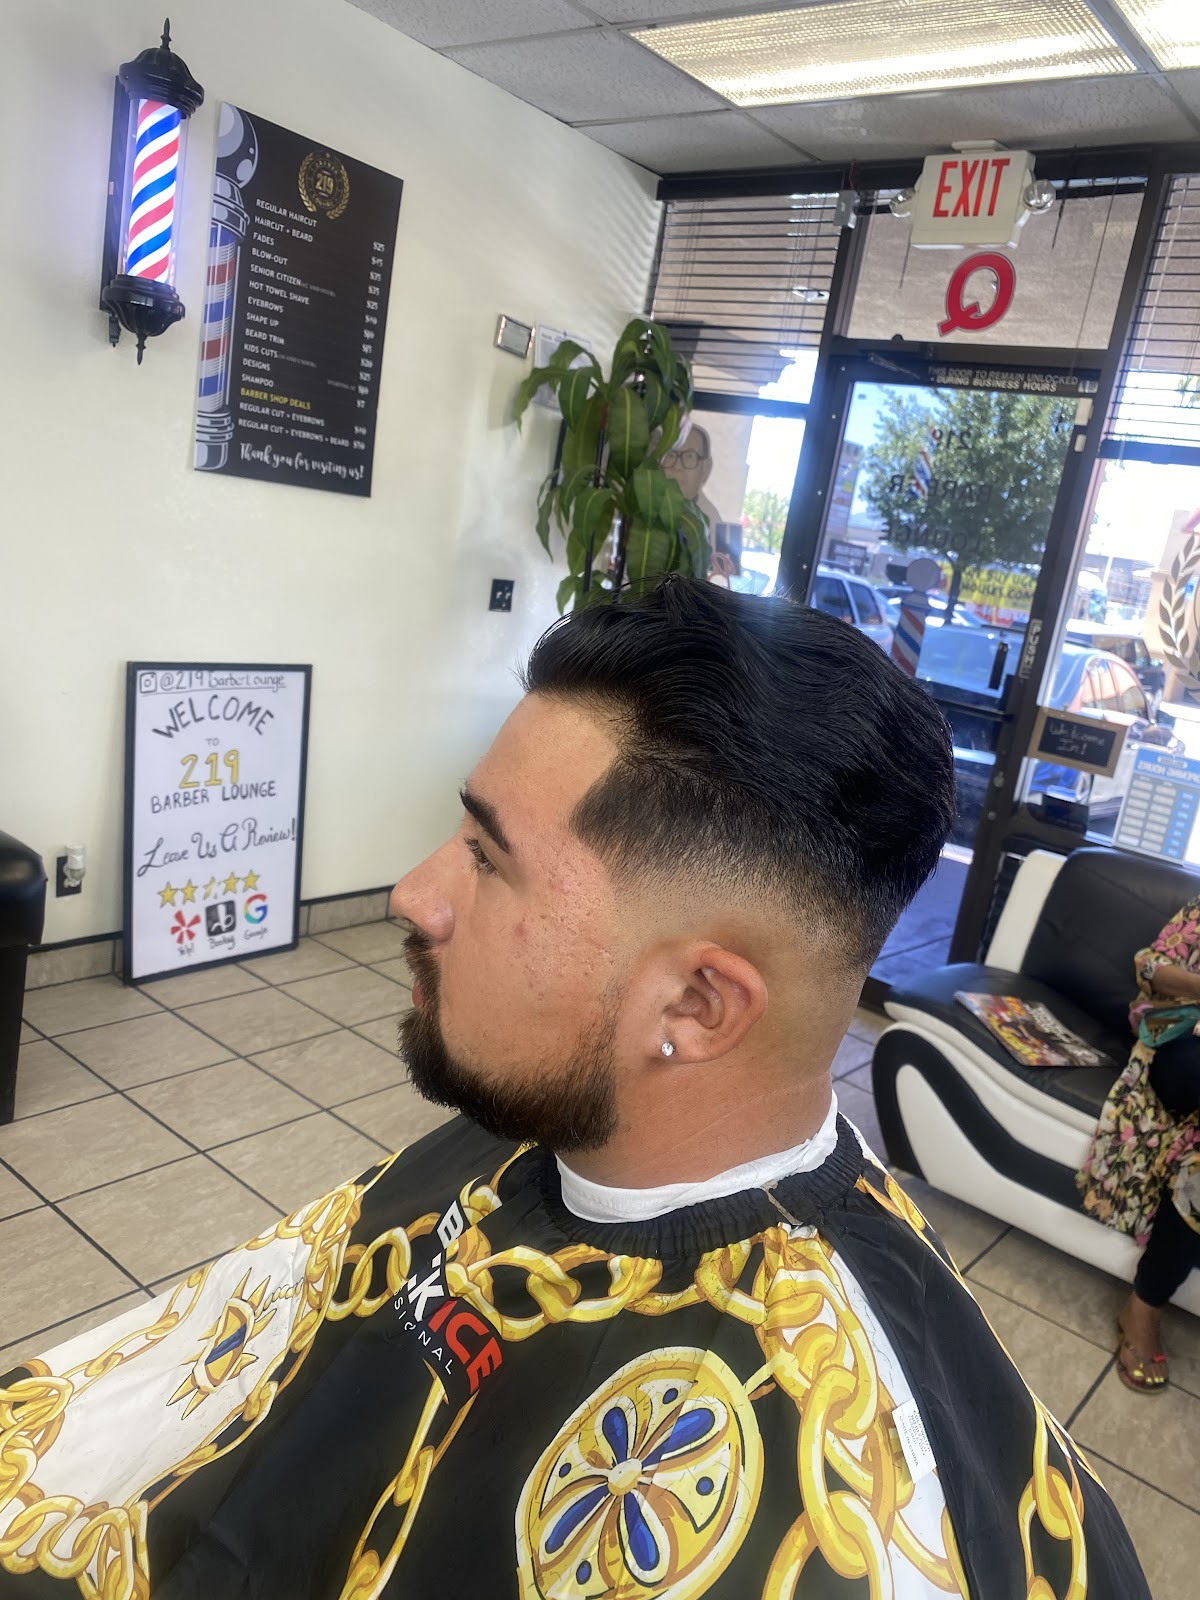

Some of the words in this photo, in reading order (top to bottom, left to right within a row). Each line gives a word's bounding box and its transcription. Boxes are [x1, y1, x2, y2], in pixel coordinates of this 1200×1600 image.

[316, 173, 334, 194] 219
[932, 158, 1011, 218] EXIT
[256, 198, 288, 217] REGULAR
[288, 211, 318, 228] HAIRCUT
[253, 231, 275, 246] FADES
[254, 215, 285, 233] HAIRCUT
[291, 228, 313, 243] BEARD
[252, 247, 289, 266] BLOW-OUT
[250, 263, 275, 279] SENIOR
[276, 271, 302, 287] CITIZEN
[247, 296, 284, 313] EYEBROWS
[249, 280, 263, 292] HOT
[265, 284, 288, 299] TOWEL
[289, 292, 310, 305] SHAVE
[246, 312, 268, 326] SHAPE
[269, 317, 279, 328] UP
[245, 328, 268, 341] BEARD
[268, 333, 285, 345] TRIM
[243, 343, 259, 354] KIDS
[260, 346, 278, 359] CUTS
[242, 358, 271, 372] DESIGNS
[947, 367, 973, 378] DOOR
[974, 369, 988, 379] TO
[988, 370, 1025, 382] REMAIN
[1026, 372, 1078, 385] UNLOCKED
[241, 373, 274, 388] SHAMPOO
[936, 376, 970, 386] DURING
[972, 377, 1020, 390] BUSINESS
[1022, 380, 1057, 393] HOURS
[240, 387, 268, 402] BARBER
[270, 392, 289, 406] SHOP
[289, 397, 311, 411] DEALS
[239, 401, 270, 416] REGULAR
[271, 408, 285, 419] CUT
[291, 412, 325, 427] EYEBROWS
[238, 418, 269, 432] REGULAR
[270, 424, 284, 435] CUT
[290, 428, 323, 443] EYEBROWS
[330, 436, 350, 448] BEARD
[240, 442, 272, 465] Thank
[272, 453, 293, 469] you
[294, 452, 310, 471] for
[311, 460, 347, 479] visiting
[348, 465, 365, 480] us!
[1024, 624, 1042, 666] PUSH
[152, 694, 275, 739] WELCOME
[206, 737, 220, 747] TO
[178, 748, 240, 789] 219
[151, 788, 210, 814] BARBER
[221, 780, 277, 802] LOUNGE
[137, 837, 190, 877] Leave
[191, 831, 217, 859] Us
[241, 817, 297, 851] Review!
[243, 926, 269, 942] Google
